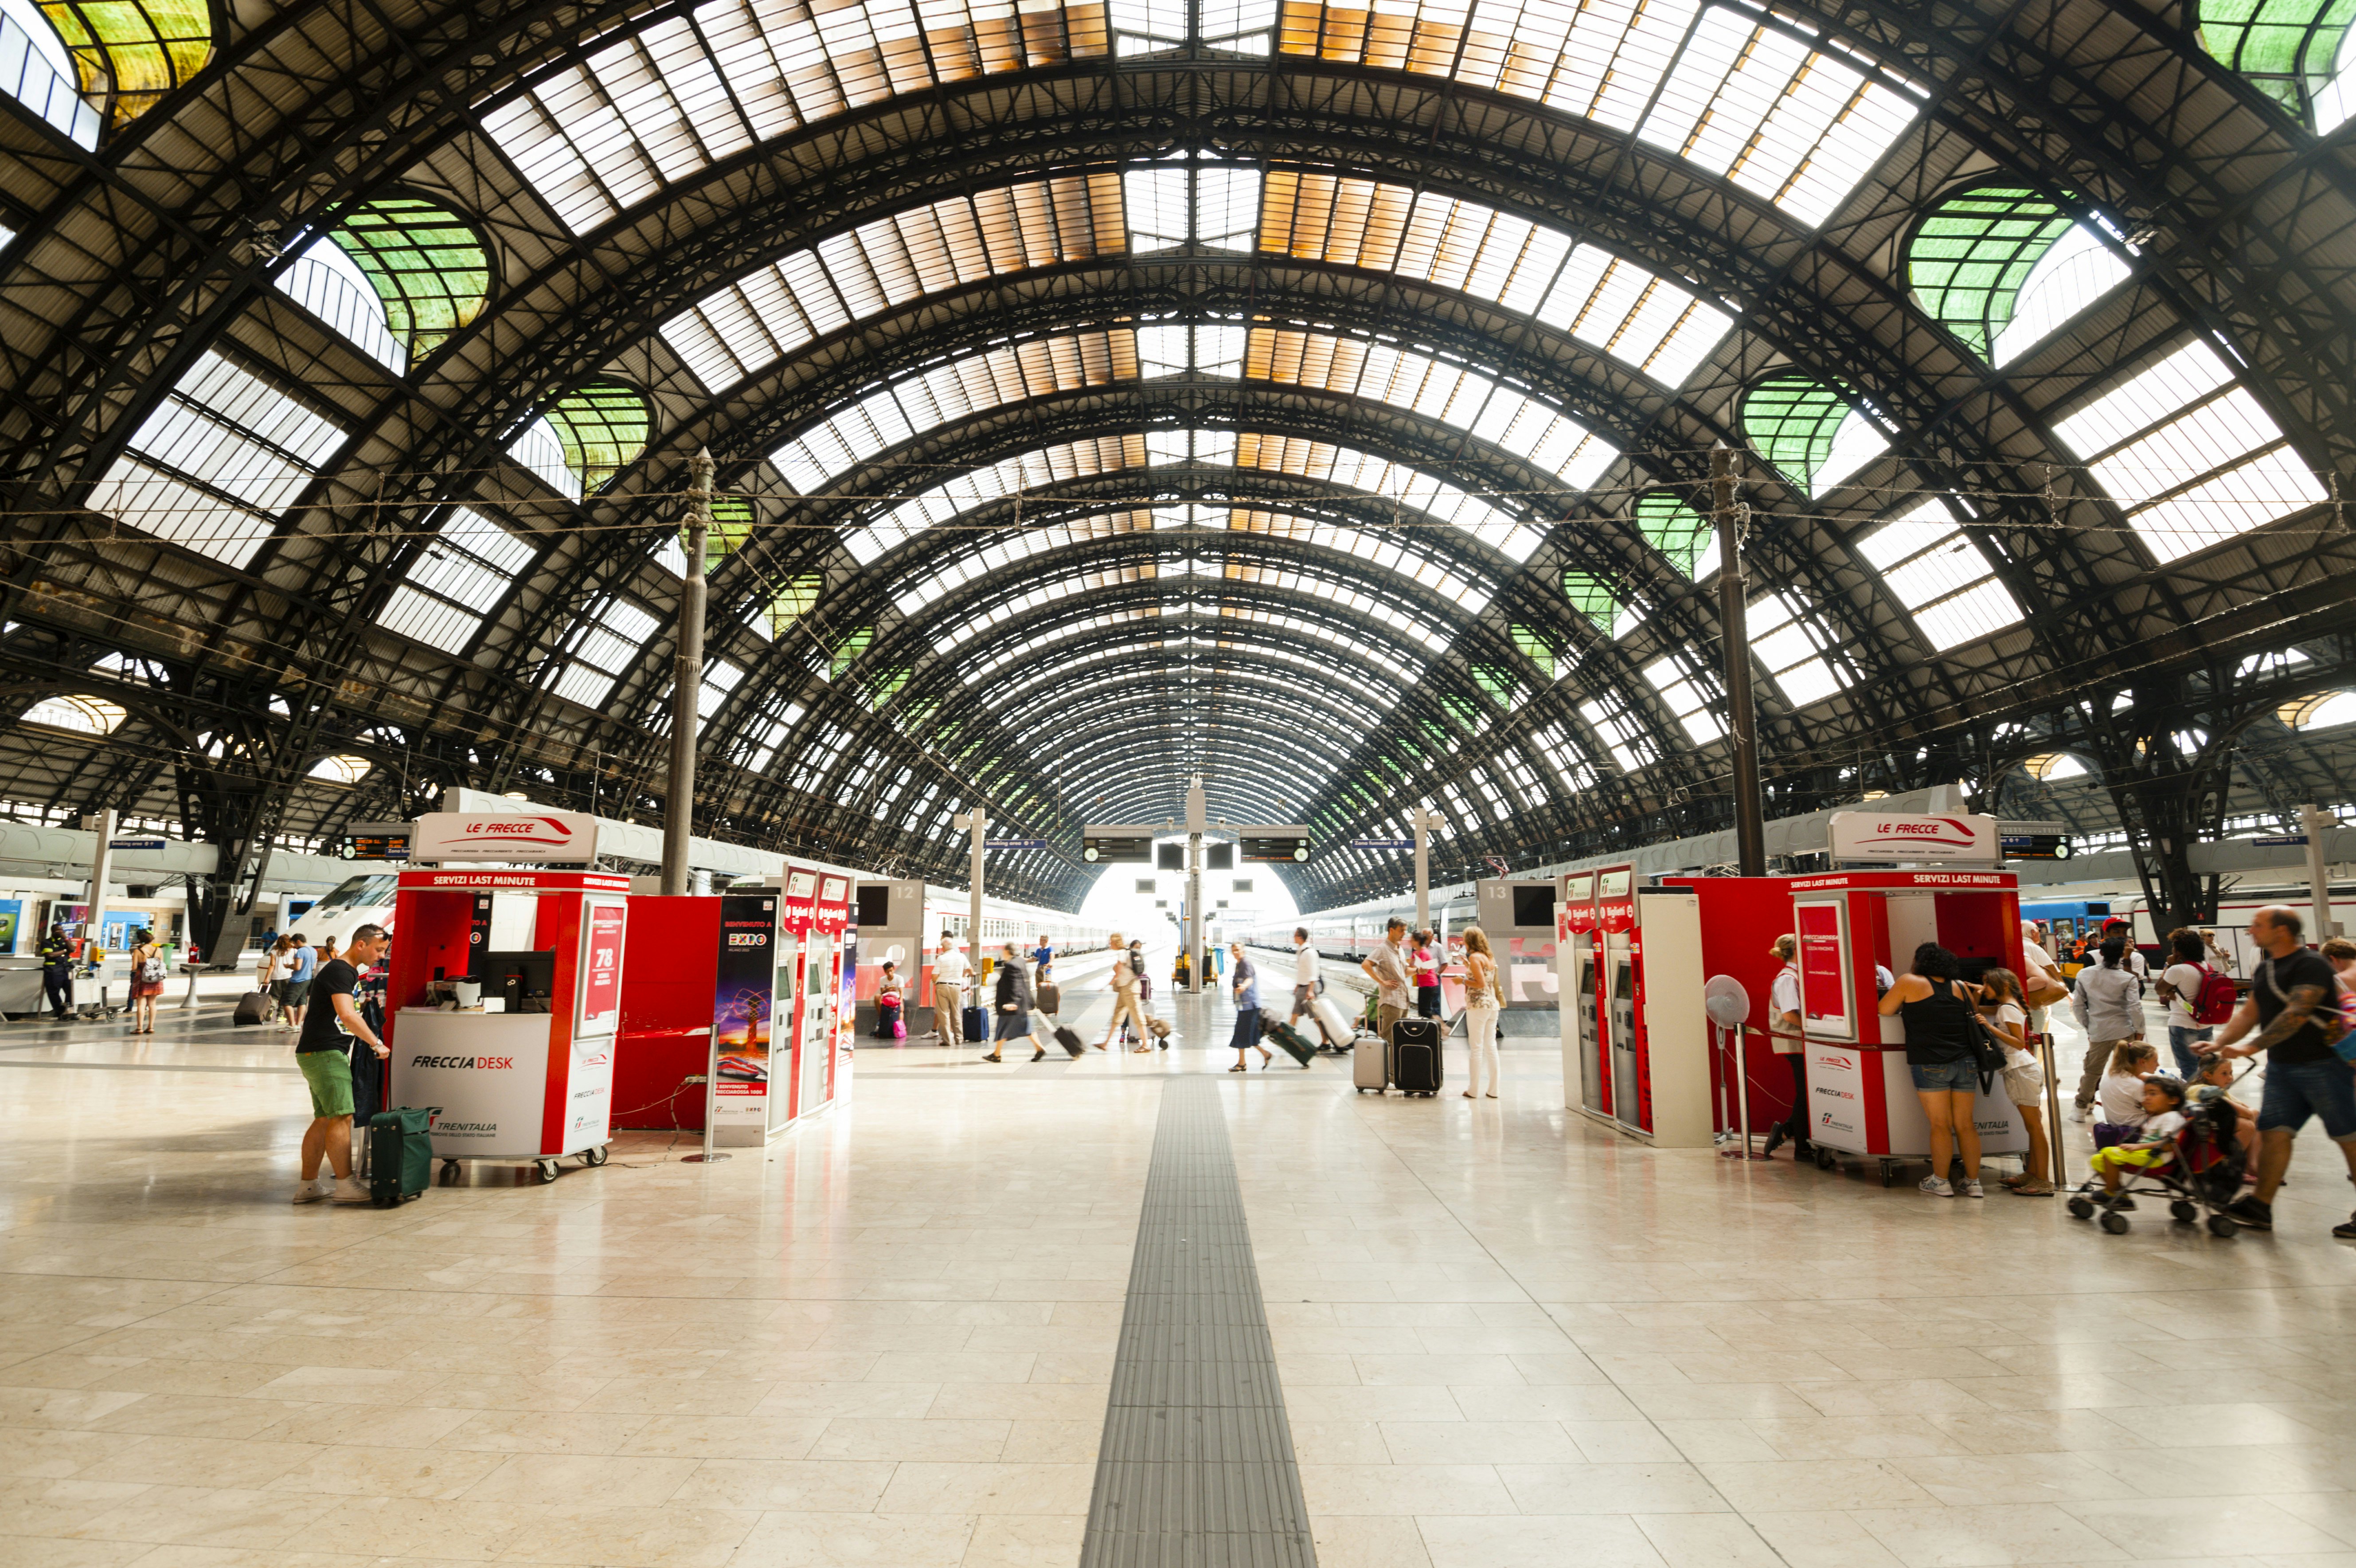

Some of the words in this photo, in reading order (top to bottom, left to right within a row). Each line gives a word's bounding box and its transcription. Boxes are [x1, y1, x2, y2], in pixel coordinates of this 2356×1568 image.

[466, 824, 483, 833] LE
[485, 824, 535, 833] FRECCE
[1877, 824, 1891, 833] LE
[1895, 824, 1939, 834] FRECCE
[434, 876, 467, 885] SERVIZI
[469, 876, 492, 885] LAST
[493, 877, 535, 886] MINUTE
[1825, 877, 1848, 886] MINUTE
[1914, 875, 1950, 883] SERVIZI
[1952, 875, 1971, 883] LAST
[1973, 875, 2000, 884] MINUTE
[896, 887, 913, 899] 12
[1488, 886, 1506, 899] 13
[1573, 908, 1589, 920] Biglietti
[1607, 906, 1625, 918] Biglietti
[728, 934, 767, 946] EXPO
[596, 948, 613, 967] 78
[1641, 1024, 1649, 1080] Servi
[1644, 1087, 1653, 1129] Self
